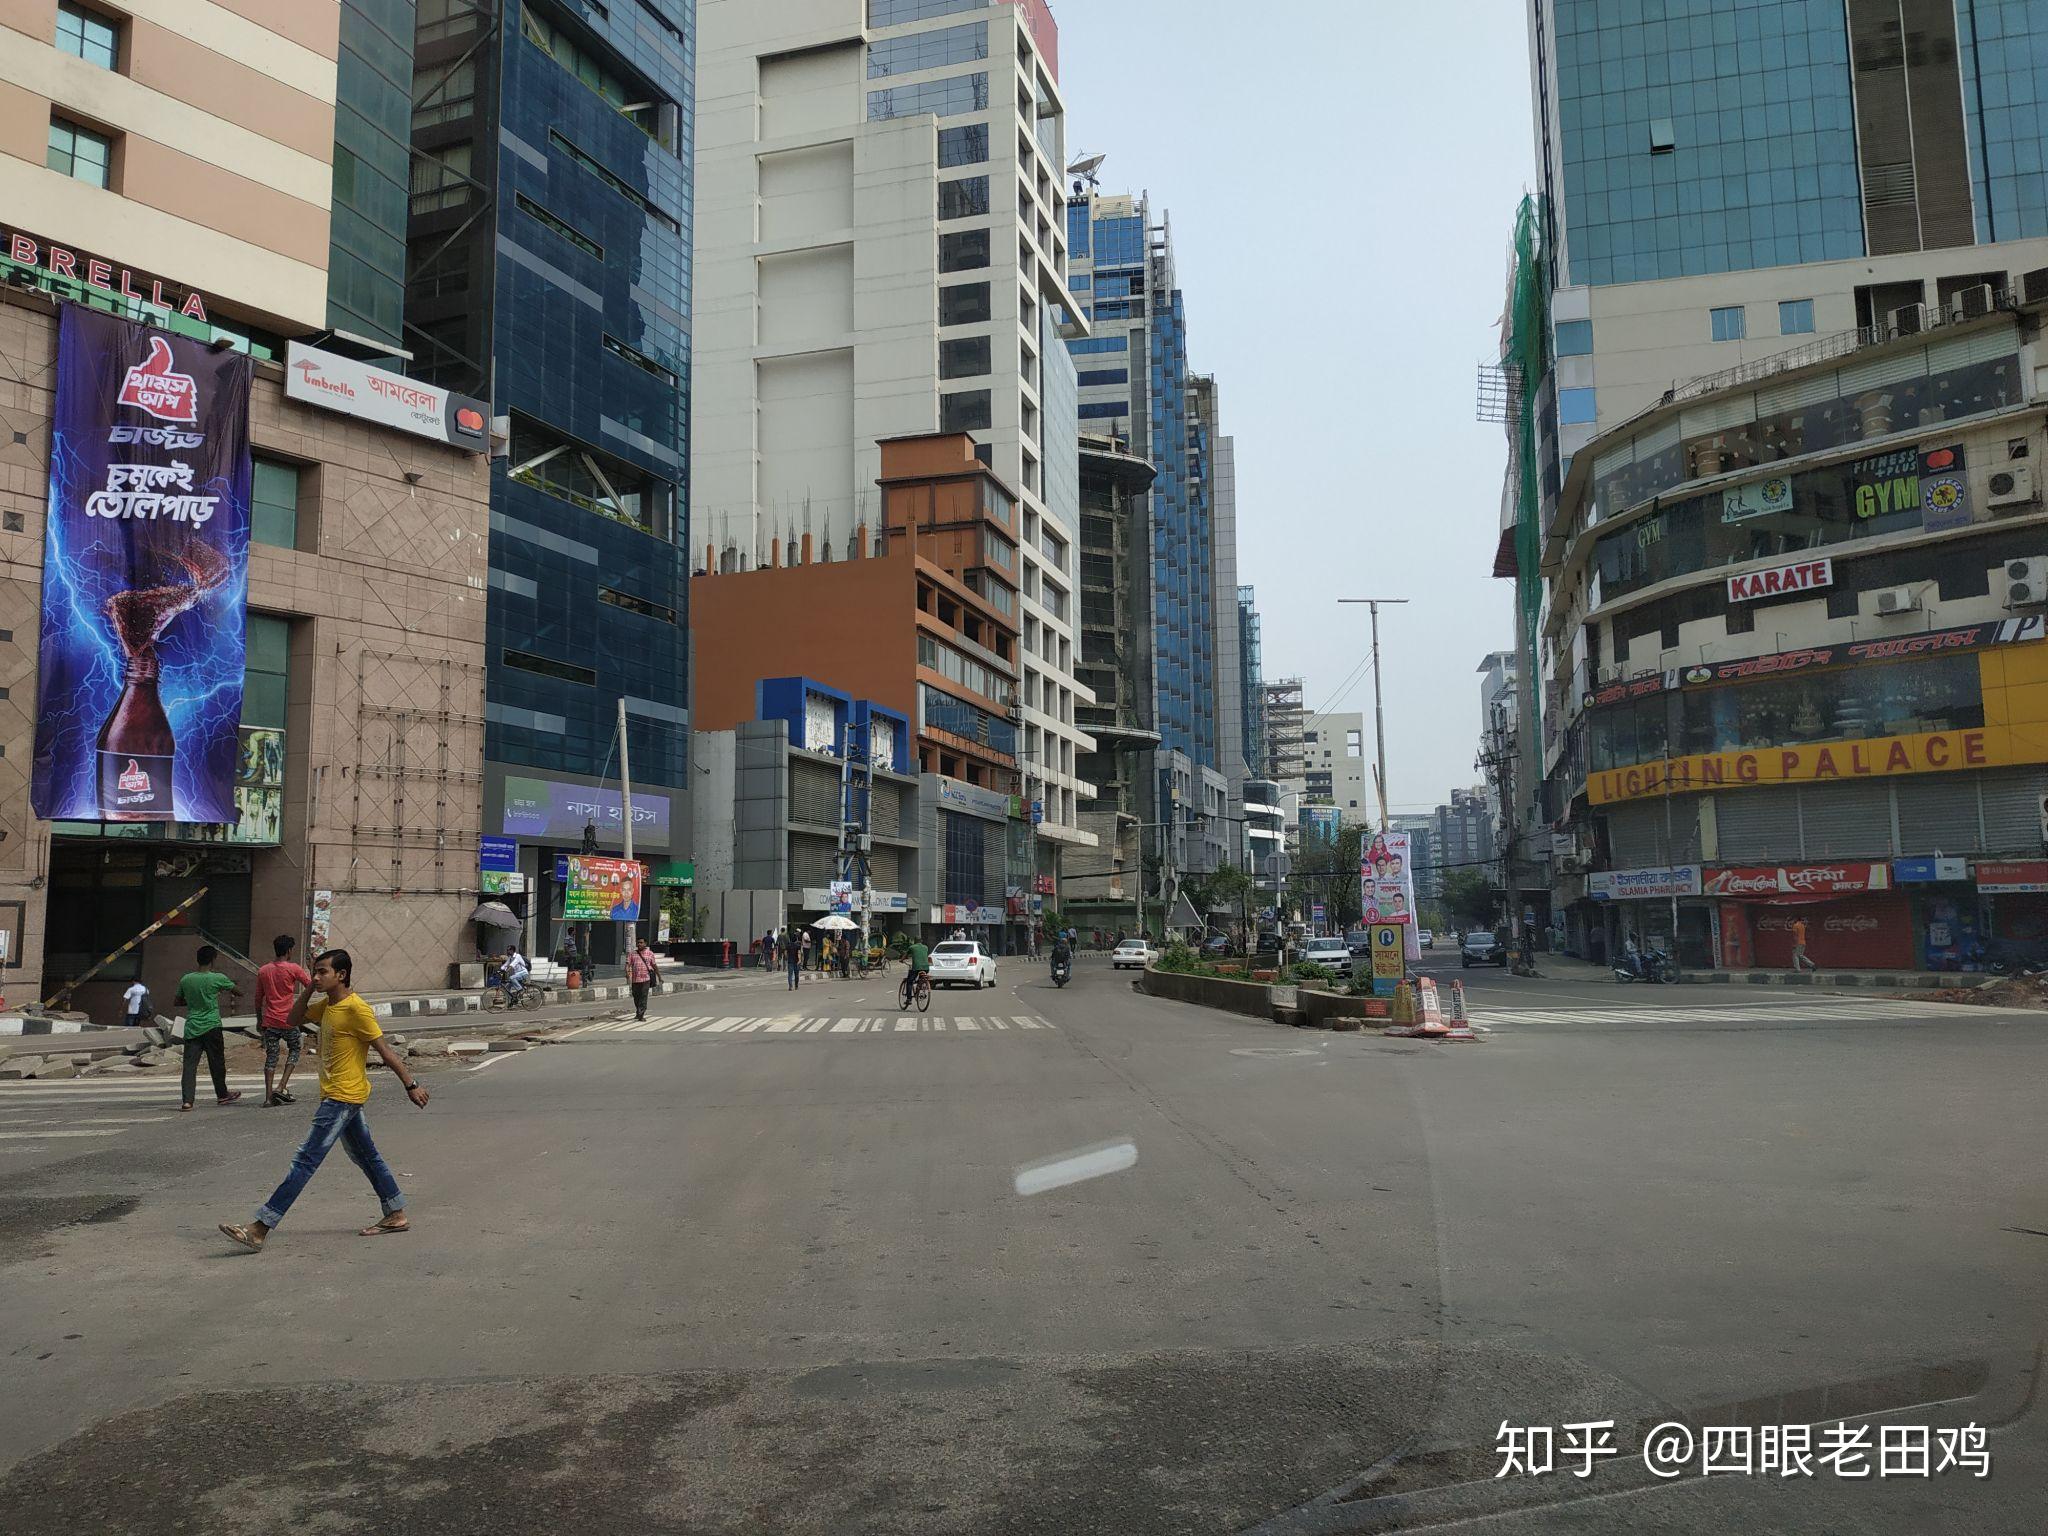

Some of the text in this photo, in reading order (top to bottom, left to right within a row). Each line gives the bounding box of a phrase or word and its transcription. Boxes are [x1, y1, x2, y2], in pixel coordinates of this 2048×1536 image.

[11, 233, 207, 322] BRELLA
[138, 390, 181, 410] আপ
[366, 374, 438, 413] আমব্রেলা
[107, 459, 195, 492] চুমুকেই
[1853, 448, 1916, 474] FITNESS
[85, 490, 219, 530] তোলপাড়
[1855, 475, 1920, 518] GYM
[1638, 521, 1661, 548] GYM
[1731, 562, 1828, 600] KARATE
[1601, 732, 1987, 801] LIGHTING PALACE
[566, 800, 657, 824] নাসা হাটস
[1649, 883, 1693, 895] PHARACY
